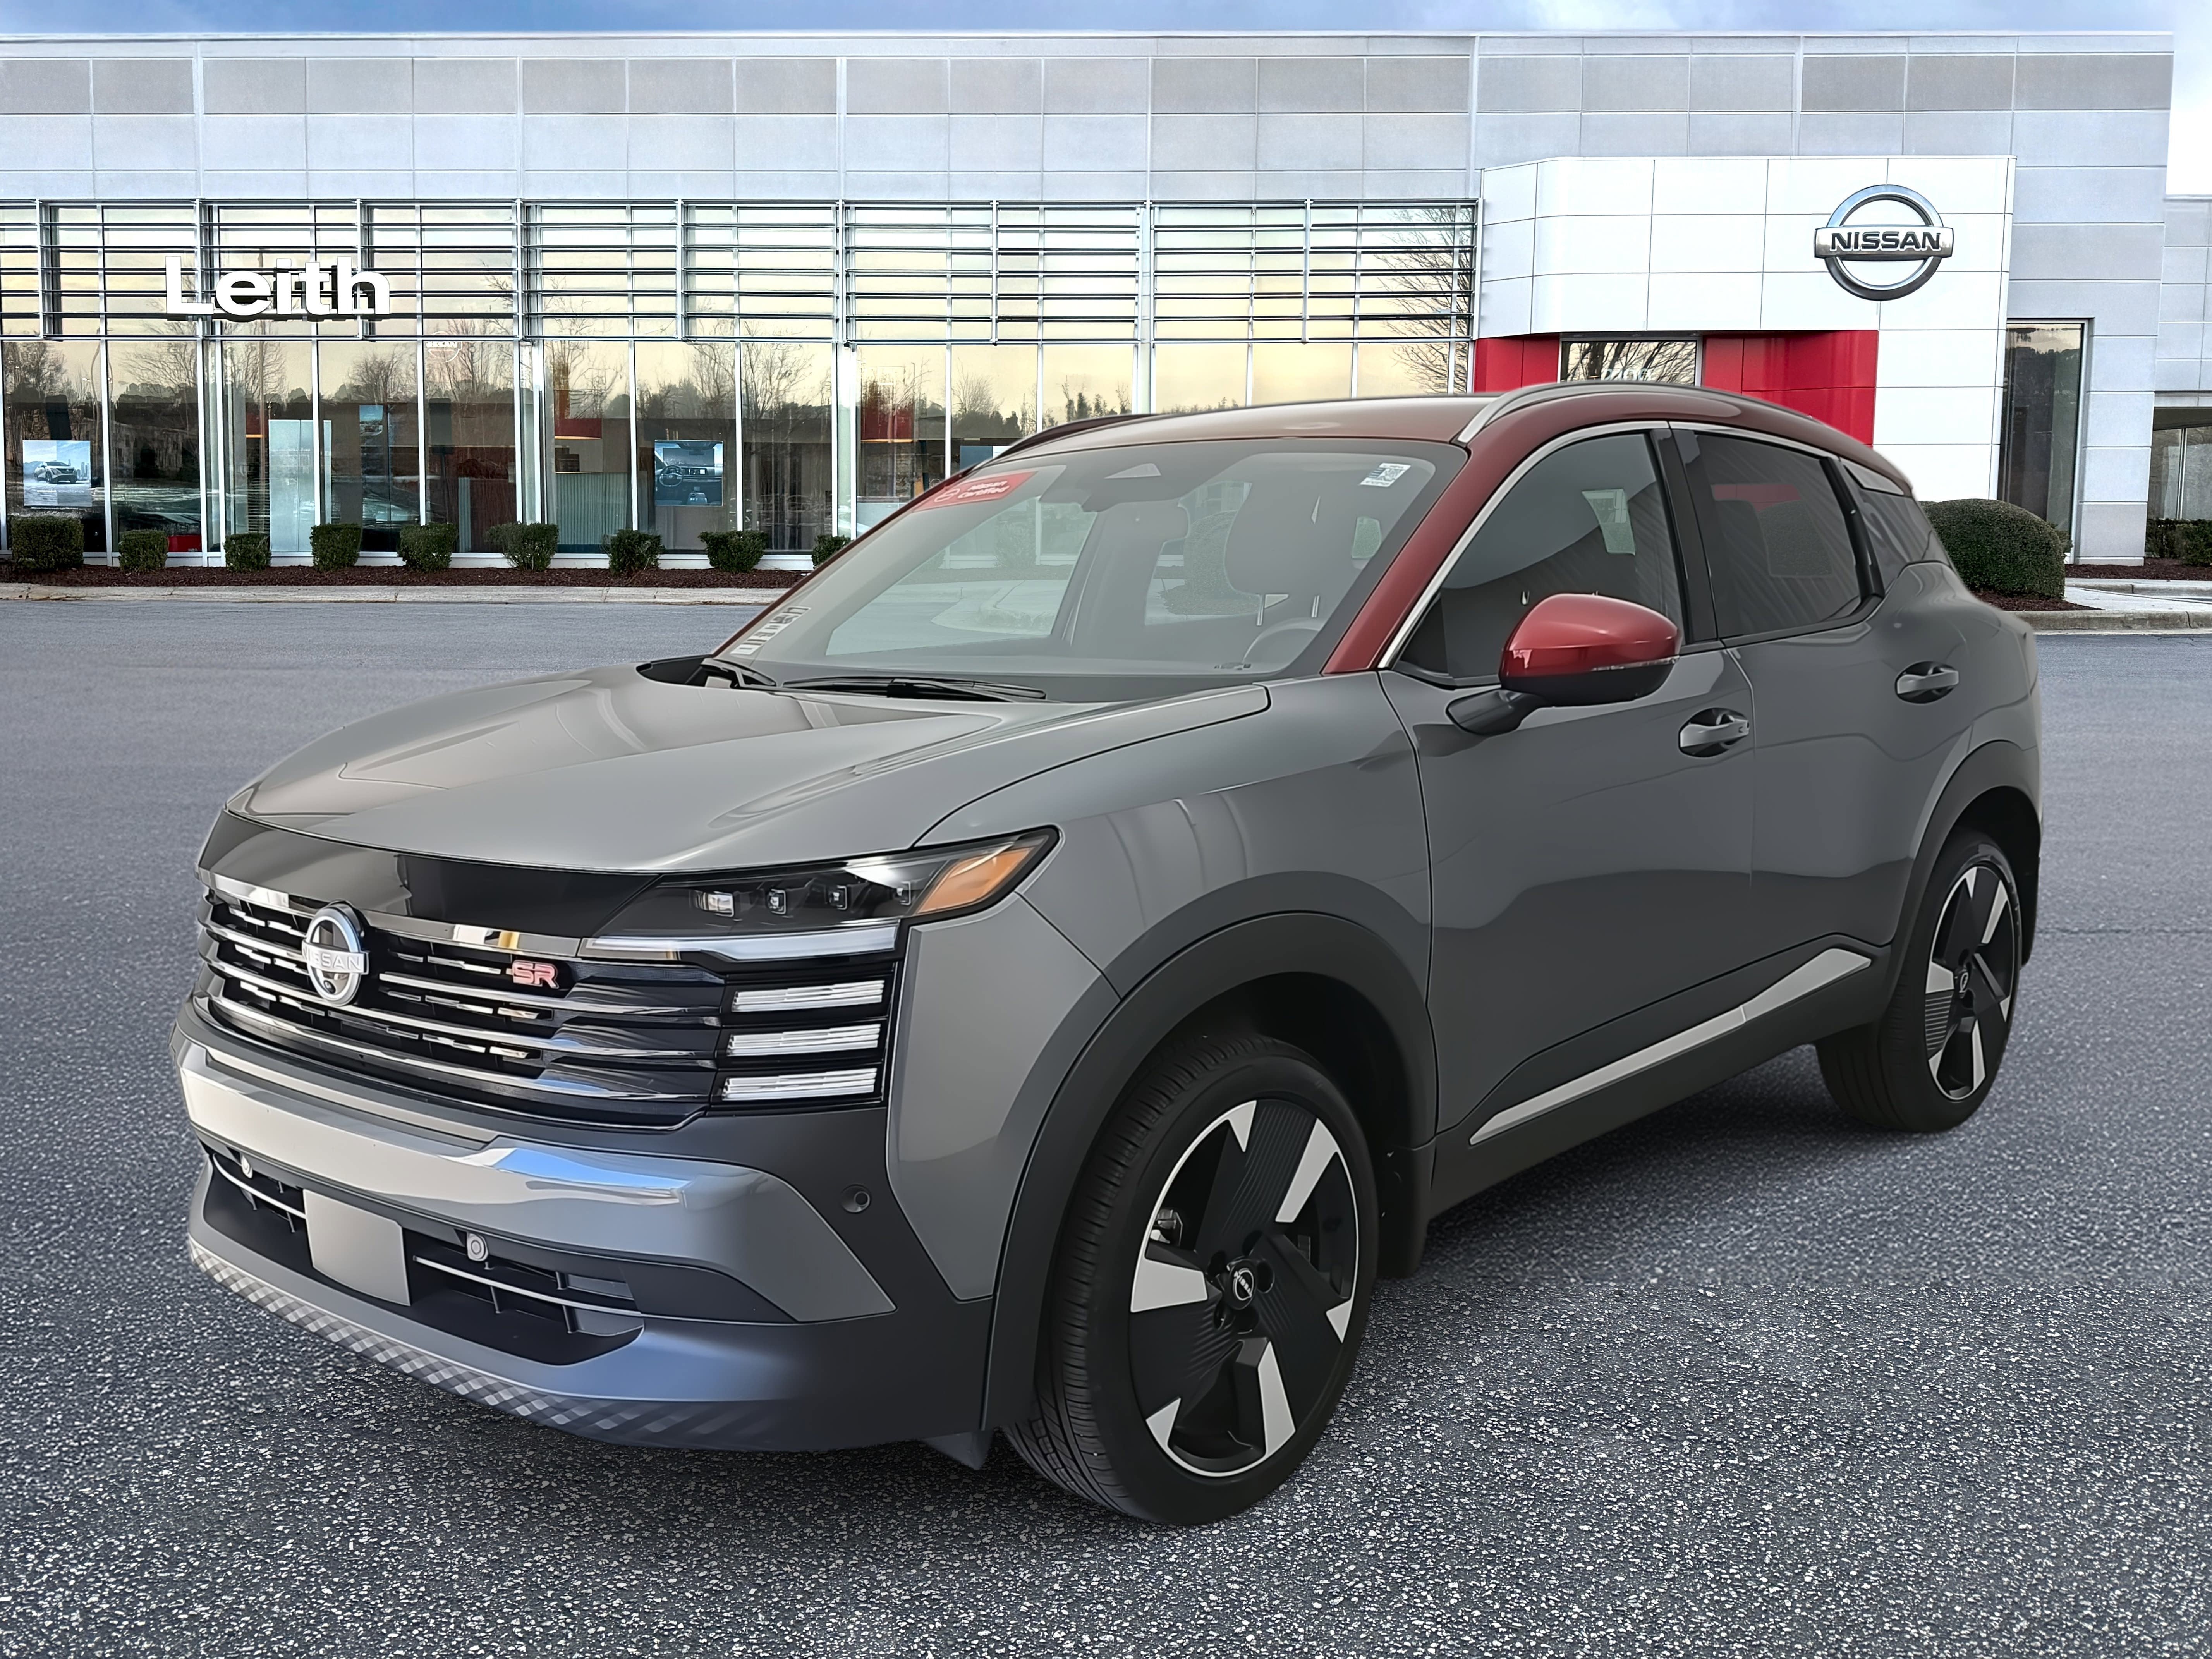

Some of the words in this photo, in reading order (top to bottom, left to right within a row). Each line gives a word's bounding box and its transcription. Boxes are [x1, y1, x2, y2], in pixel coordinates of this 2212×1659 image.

[1831, 232, 1941, 251] NISSAN
[165, 256, 390, 316] Leith
[302, 946, 361, 970] NISSAN
[512, 960, 559, 989] SR
